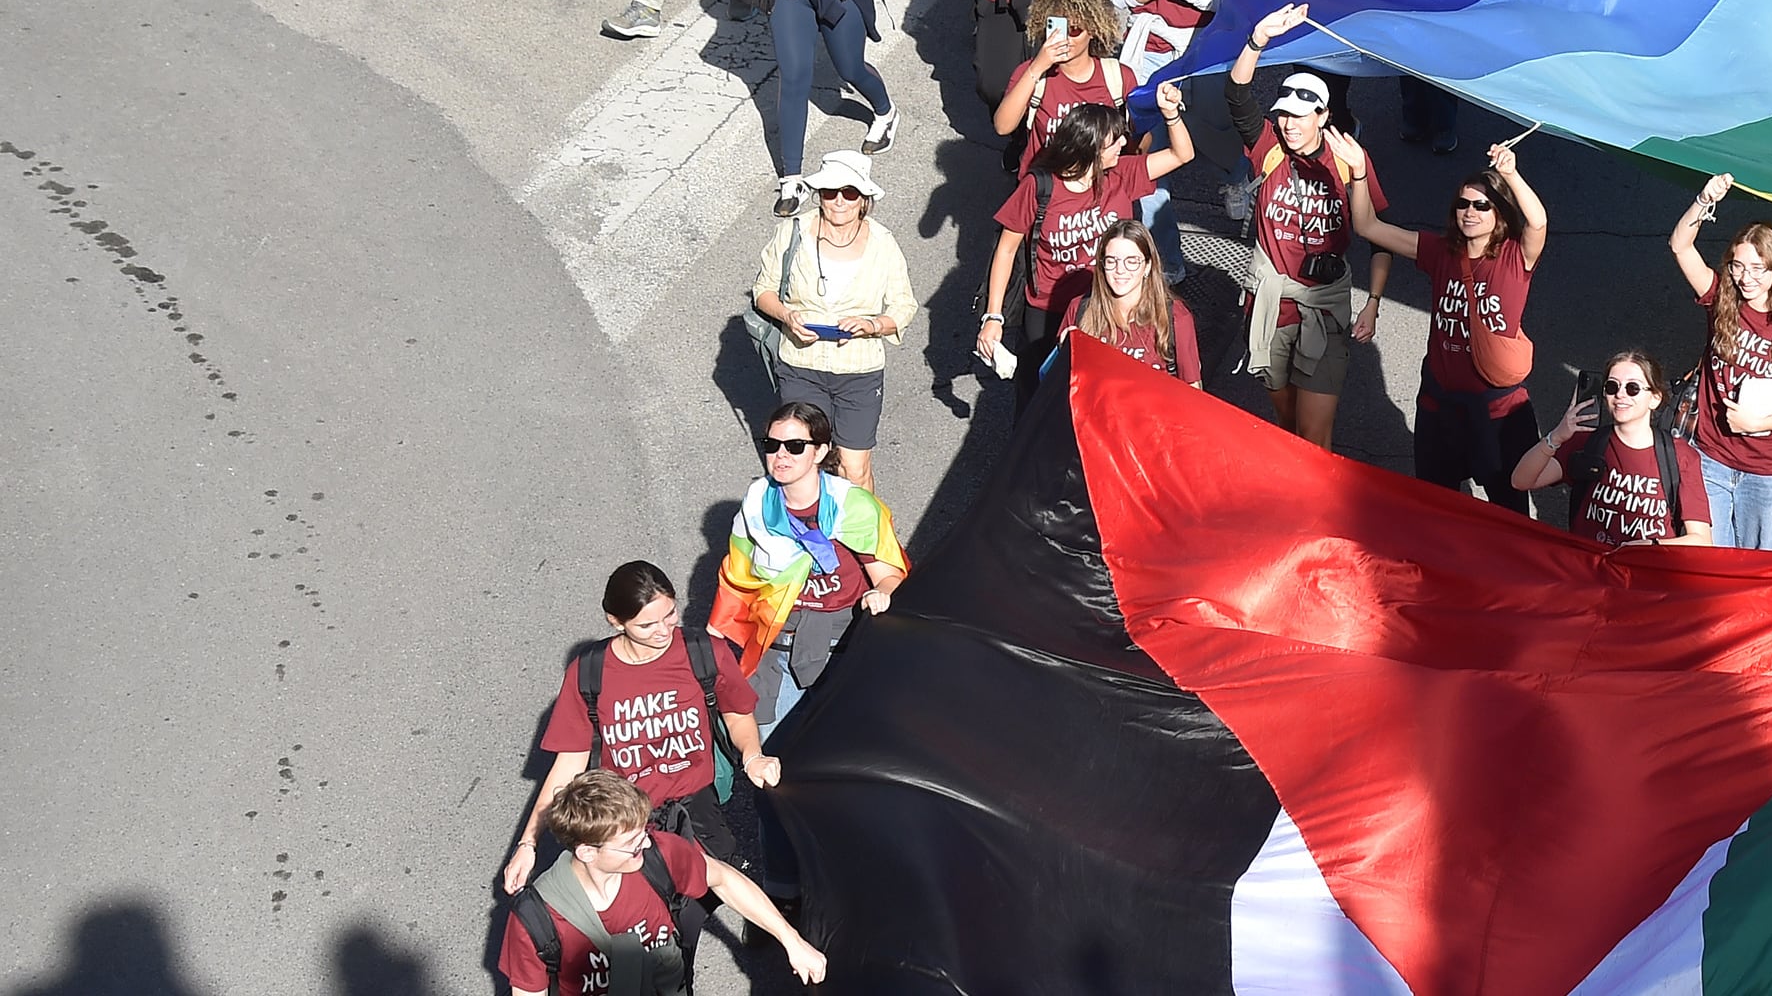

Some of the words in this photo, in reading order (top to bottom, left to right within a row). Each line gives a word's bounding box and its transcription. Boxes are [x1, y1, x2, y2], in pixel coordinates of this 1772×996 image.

[1265, 201, 1297, 227] NOT
[1609, 468, 1660, 495] MAKE
[1592, 483, 1667, 518] HUMMUS
[1586, 503, 1618, 530] NOT
[1620, 515, 1666, 541] WALLS
[803, 575, 841, 599] ALLS
[614, 690, 679, 722] MAKE
[603, 707, 700, 745] HUMMUS
[645, 730, 705, 759] WALLS
